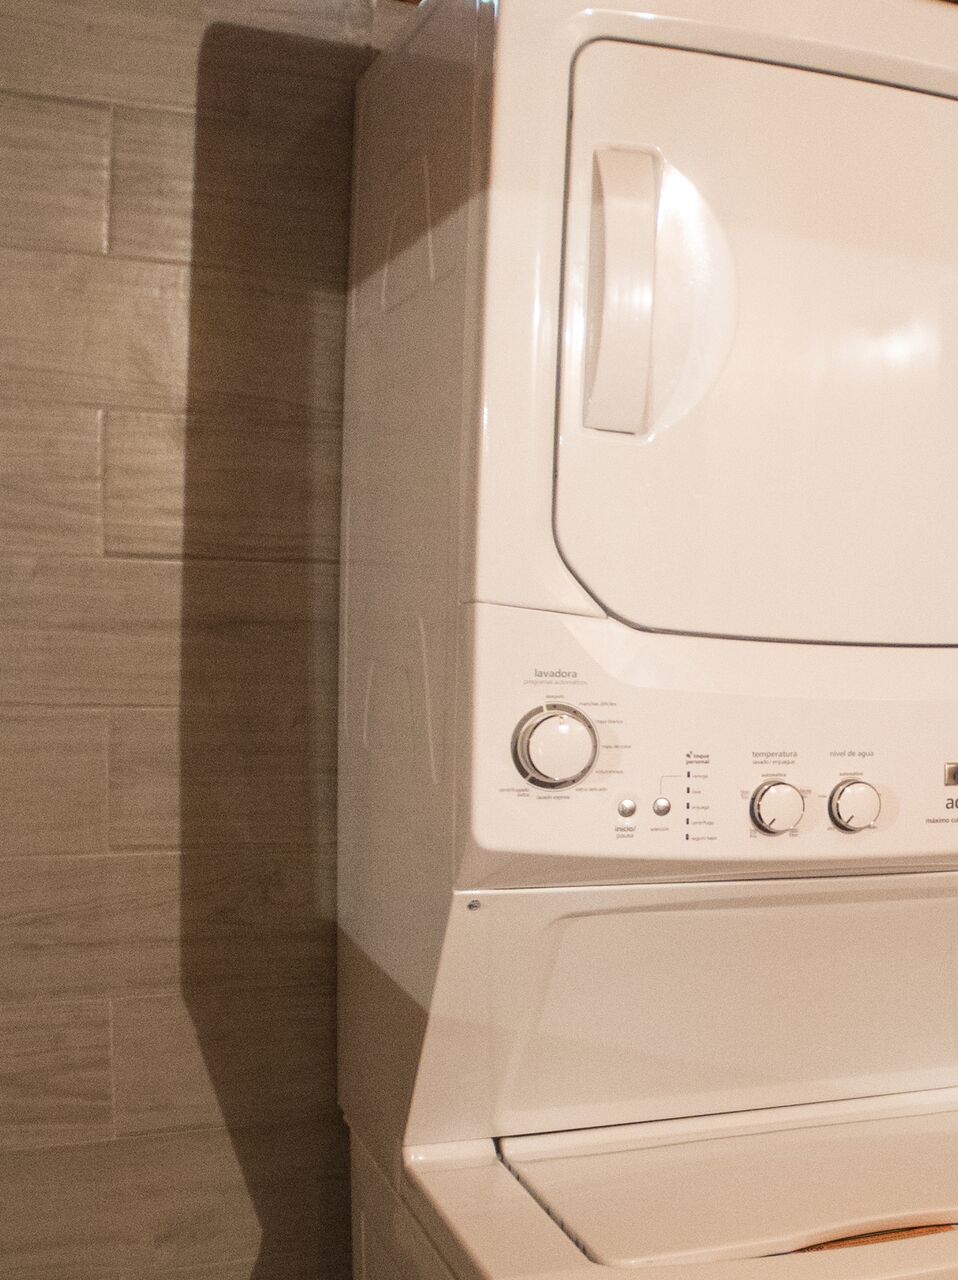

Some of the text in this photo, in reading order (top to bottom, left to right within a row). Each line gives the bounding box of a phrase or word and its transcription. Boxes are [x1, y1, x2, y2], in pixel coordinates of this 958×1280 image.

[534, 668, 578, 678] lavadora
[752, 751, 798, 760] temperatura
[857, 751, 875, 759] agua
